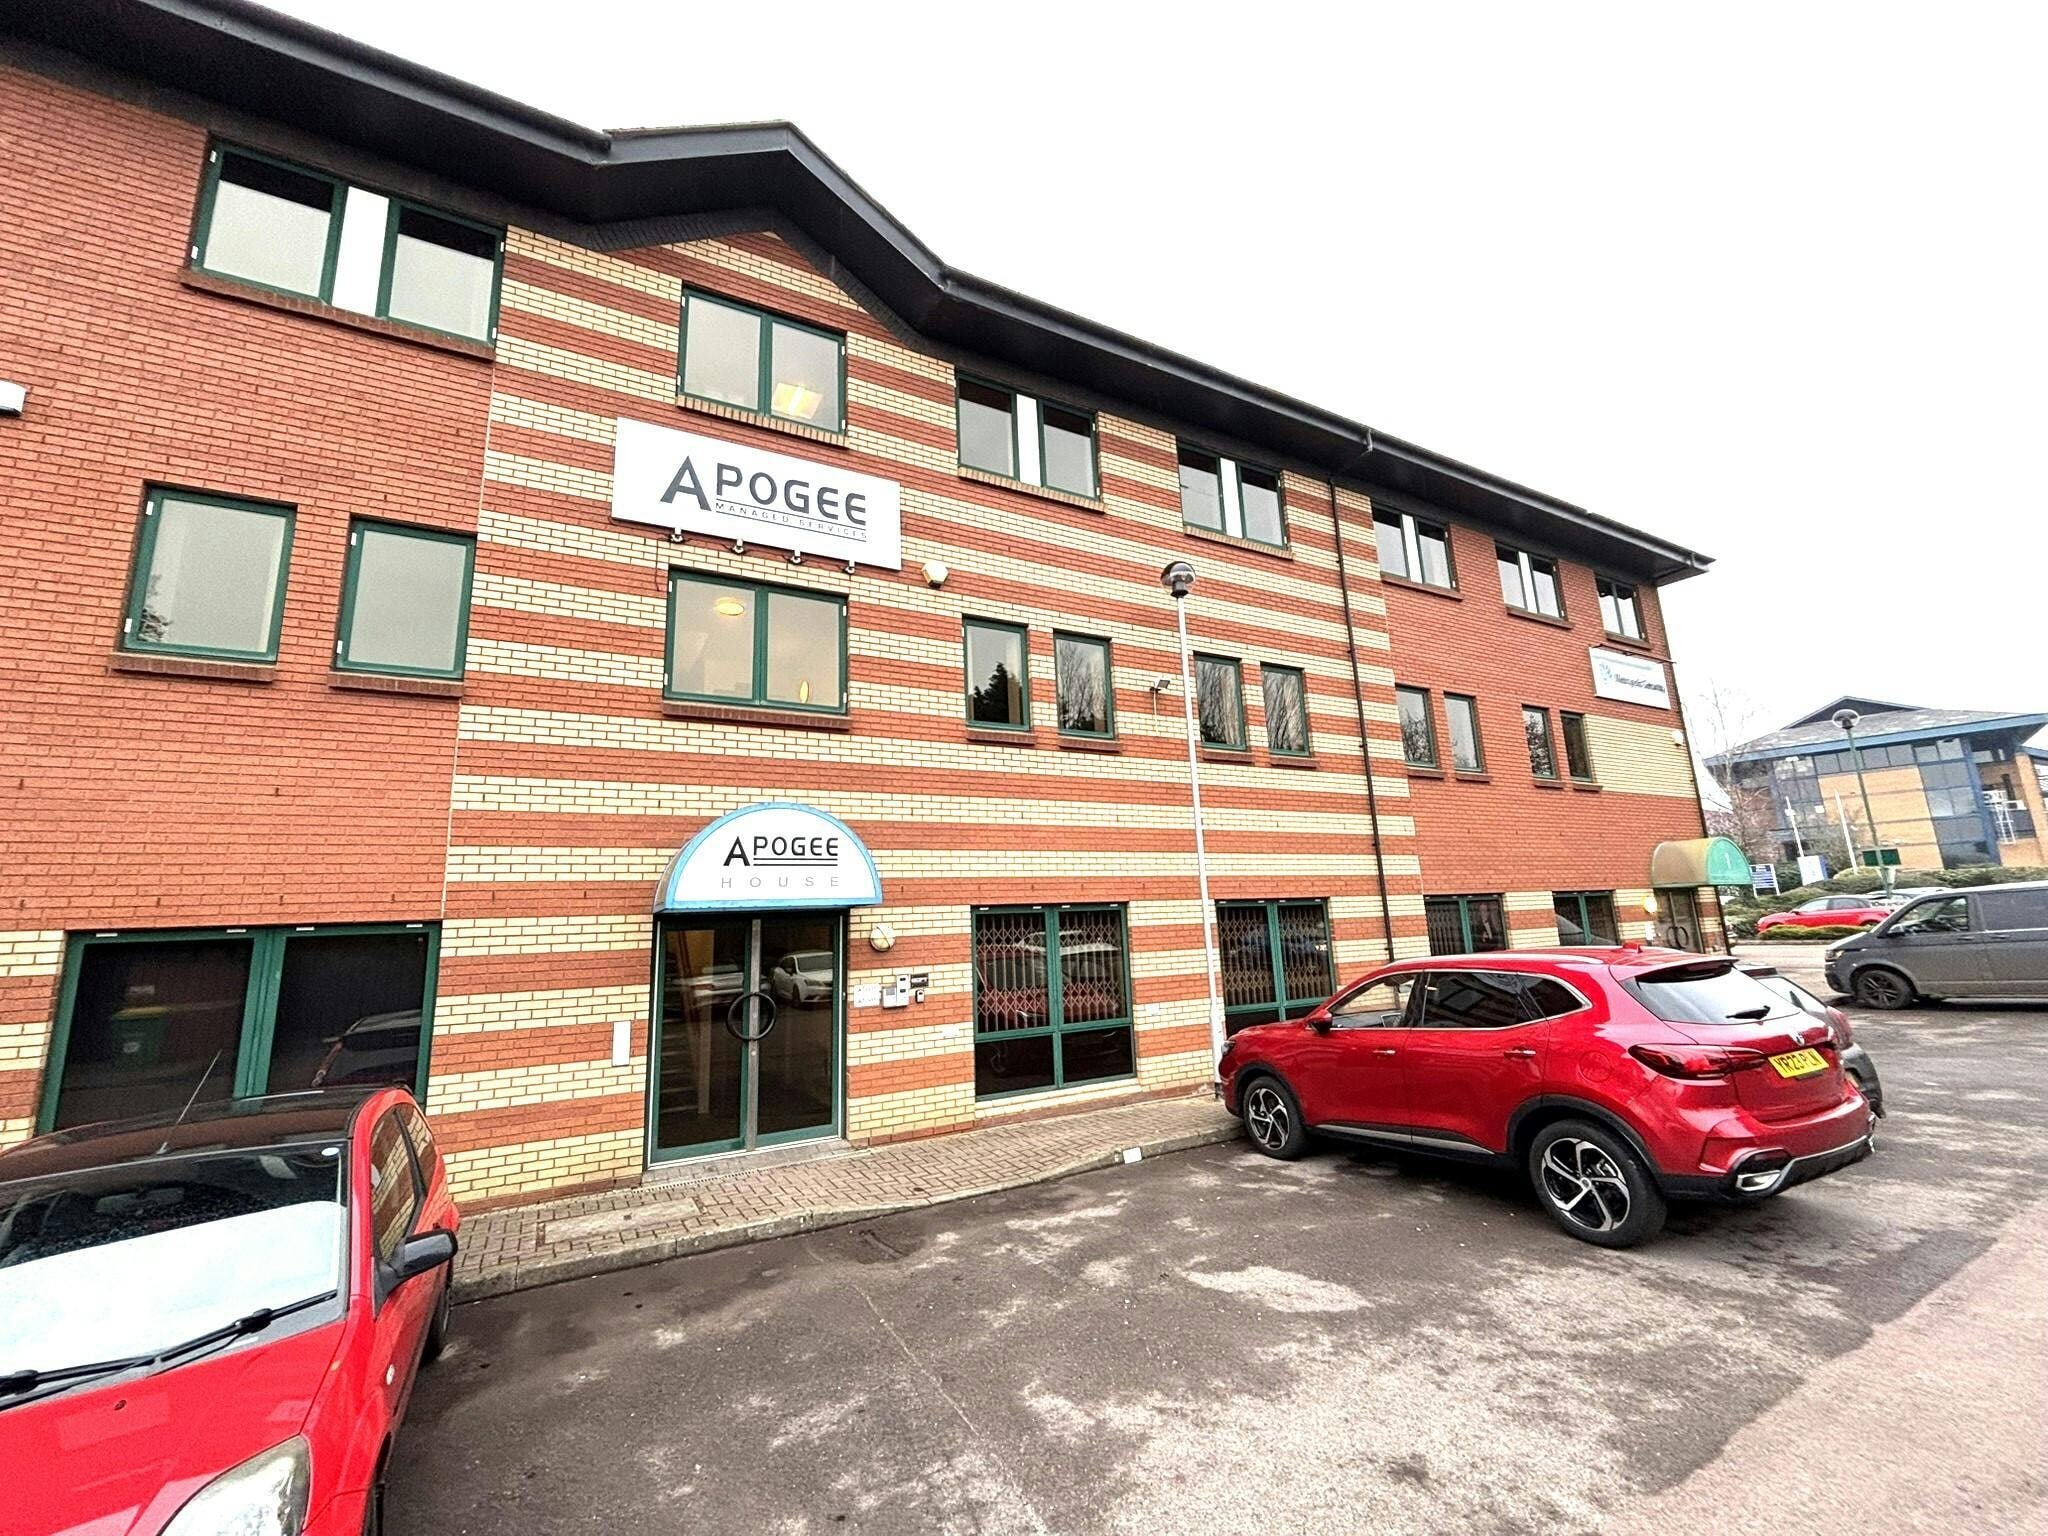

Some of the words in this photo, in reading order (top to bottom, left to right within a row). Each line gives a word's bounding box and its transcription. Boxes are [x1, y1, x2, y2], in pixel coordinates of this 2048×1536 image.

[660, 455, 866, 526] APOGEE
[715, 502, 789, 523] MANAGED
[799, 519, 867, 539] SERVICES
[723, 836, 838, 866] APOGEE
[721, 876, 839, 888] HOUSE
